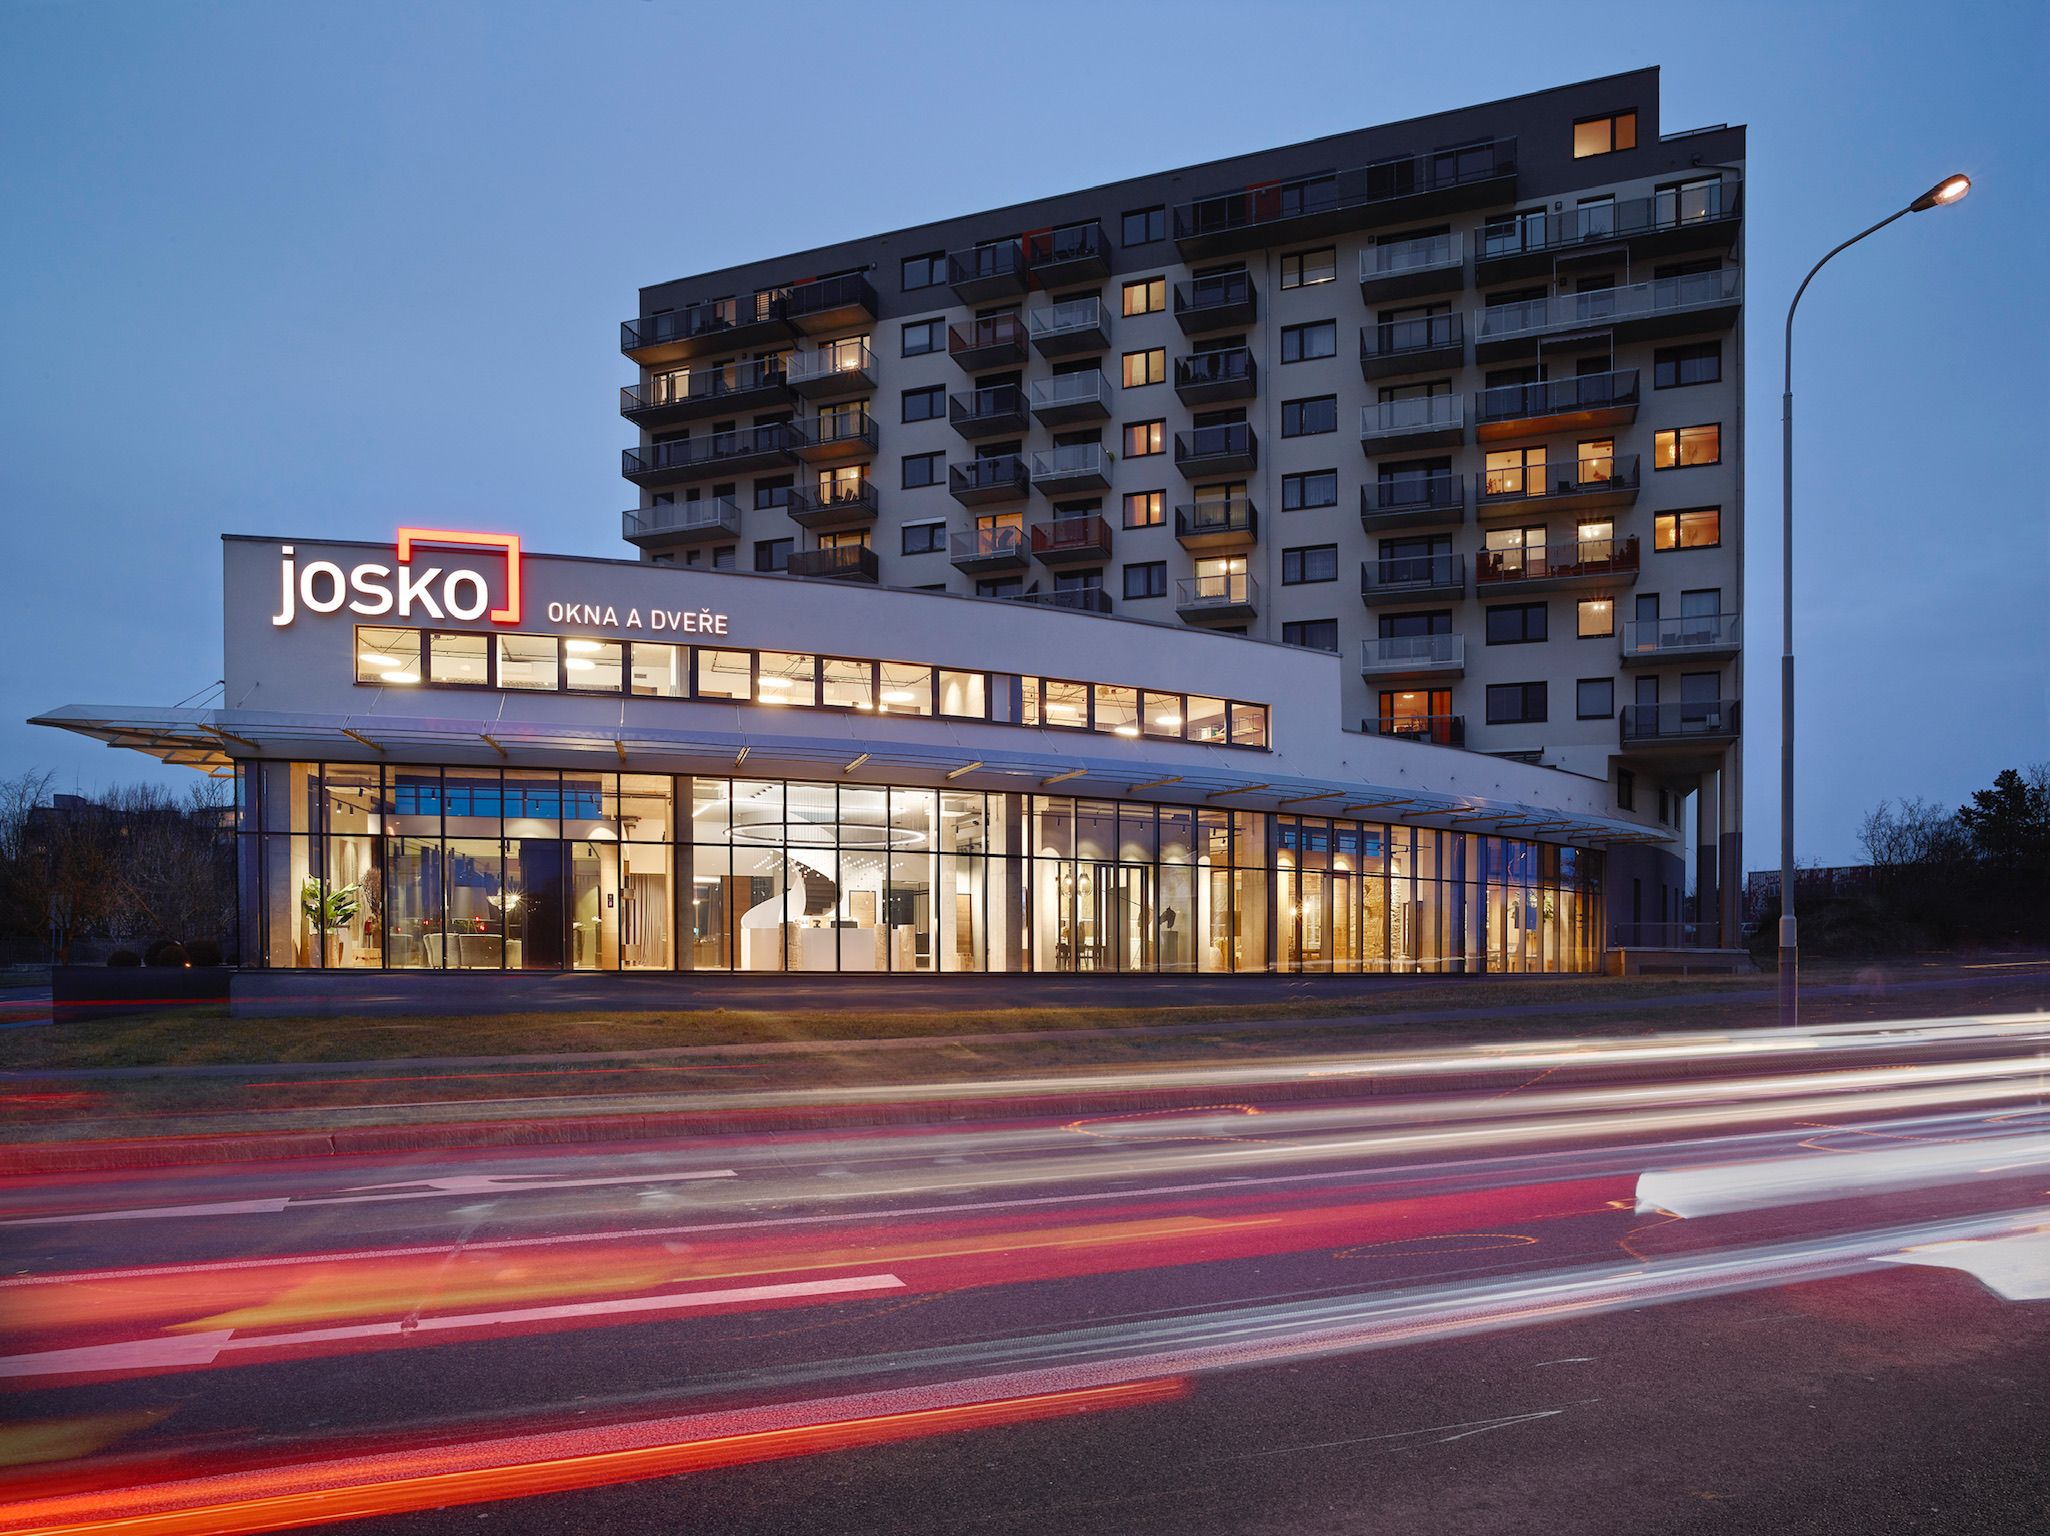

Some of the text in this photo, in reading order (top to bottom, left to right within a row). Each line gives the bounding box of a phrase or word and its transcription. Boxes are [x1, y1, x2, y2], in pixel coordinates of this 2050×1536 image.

[548, 602, 728, 635] OKNA A DVEŘE
